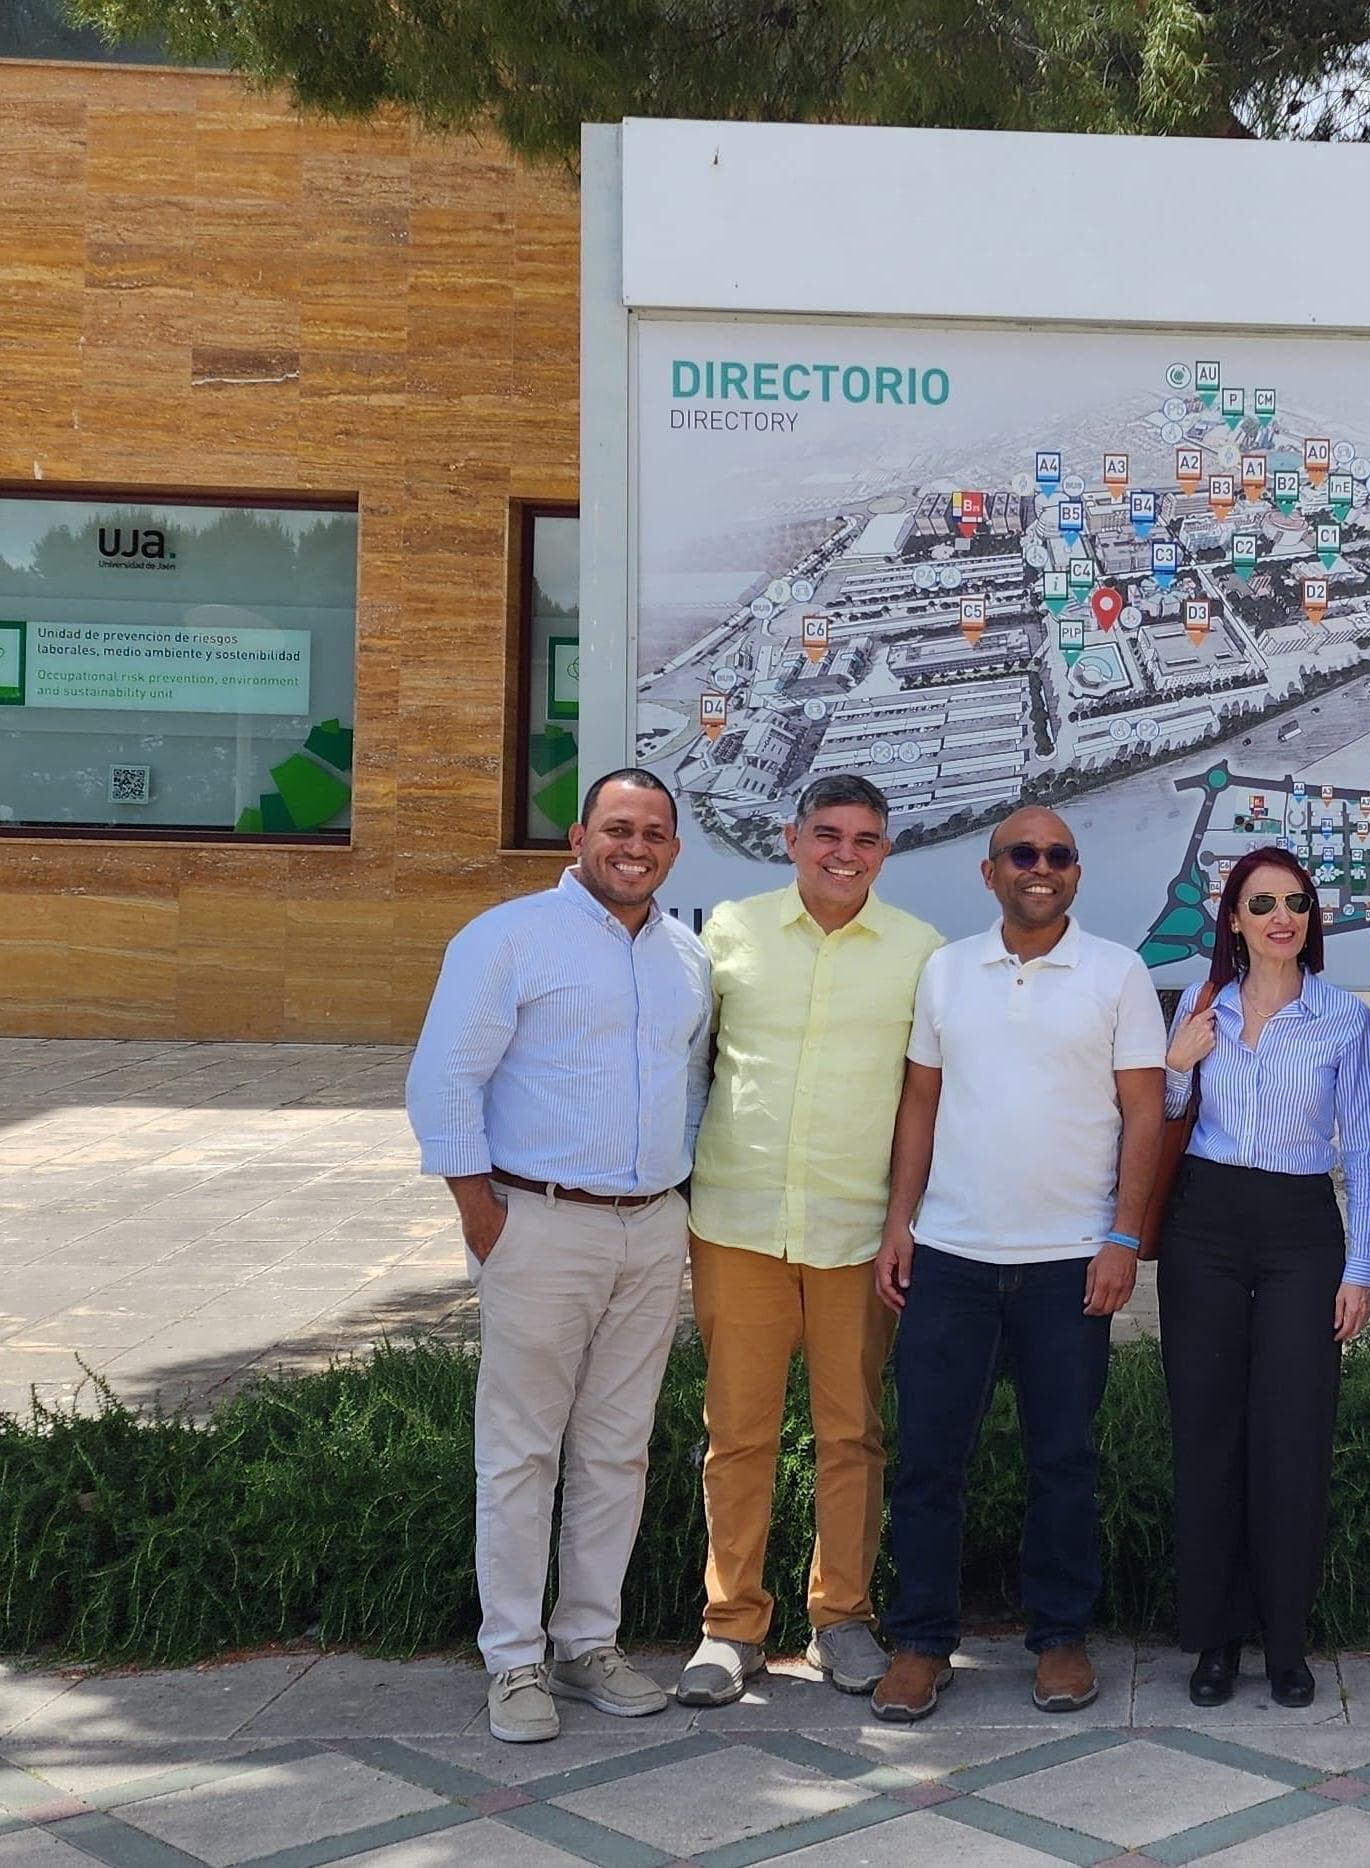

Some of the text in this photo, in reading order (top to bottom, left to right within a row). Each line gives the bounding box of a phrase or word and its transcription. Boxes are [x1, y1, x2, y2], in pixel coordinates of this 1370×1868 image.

[1200, 367, 1216, 380] AU
[672, 360, 951, 406] DIRECTORIO
[1229, 393, 1238, 406] P
[1257, 393, 1273, 406] CM
[670, 408, 799, 432] DIRECTORY
[1307, 445, 1327, 459] A0
[1039, 458, 1057, 472] A4
[1107, 460, 1126, 473] A3
[1179, 456, 1199, 470] A2
[1246, 463, 1262, 477] A1
[1212, 481, 1231, 495] B3
[1278, 477, 1295, 491] B2
[1133, 496, 1152, 511] B4
[1062, 507, 1080, 521] B5
[1320, 530, 1338, 544] C1
[1235, 540, 1253, 554] C2
[1155, 549, 1174, 563] C3
[98, 560, 145, 569] Universidad
[1073, 564, 1091, 577] C4
[1306, 586, 1325, 599] D2
[963, 605, 982, 619] C5
[1188, 606, 1207, 620] D3
[806, 622, 825, 637] C6
[37, 628, 82, 640] Unidad
[84, 629, 99, 640] de
[174, 632, 190, 643] de
[192, 633, 239, 647] riesgos
[37, 644, 301, 662] laborales, medio ambiente y sostenibilidad
[37, 669, 299, 687] Occupational risk prevention, environment
[37, 685, 174, 700] and sustainability unit
[704, 700, 723, 714] D4
